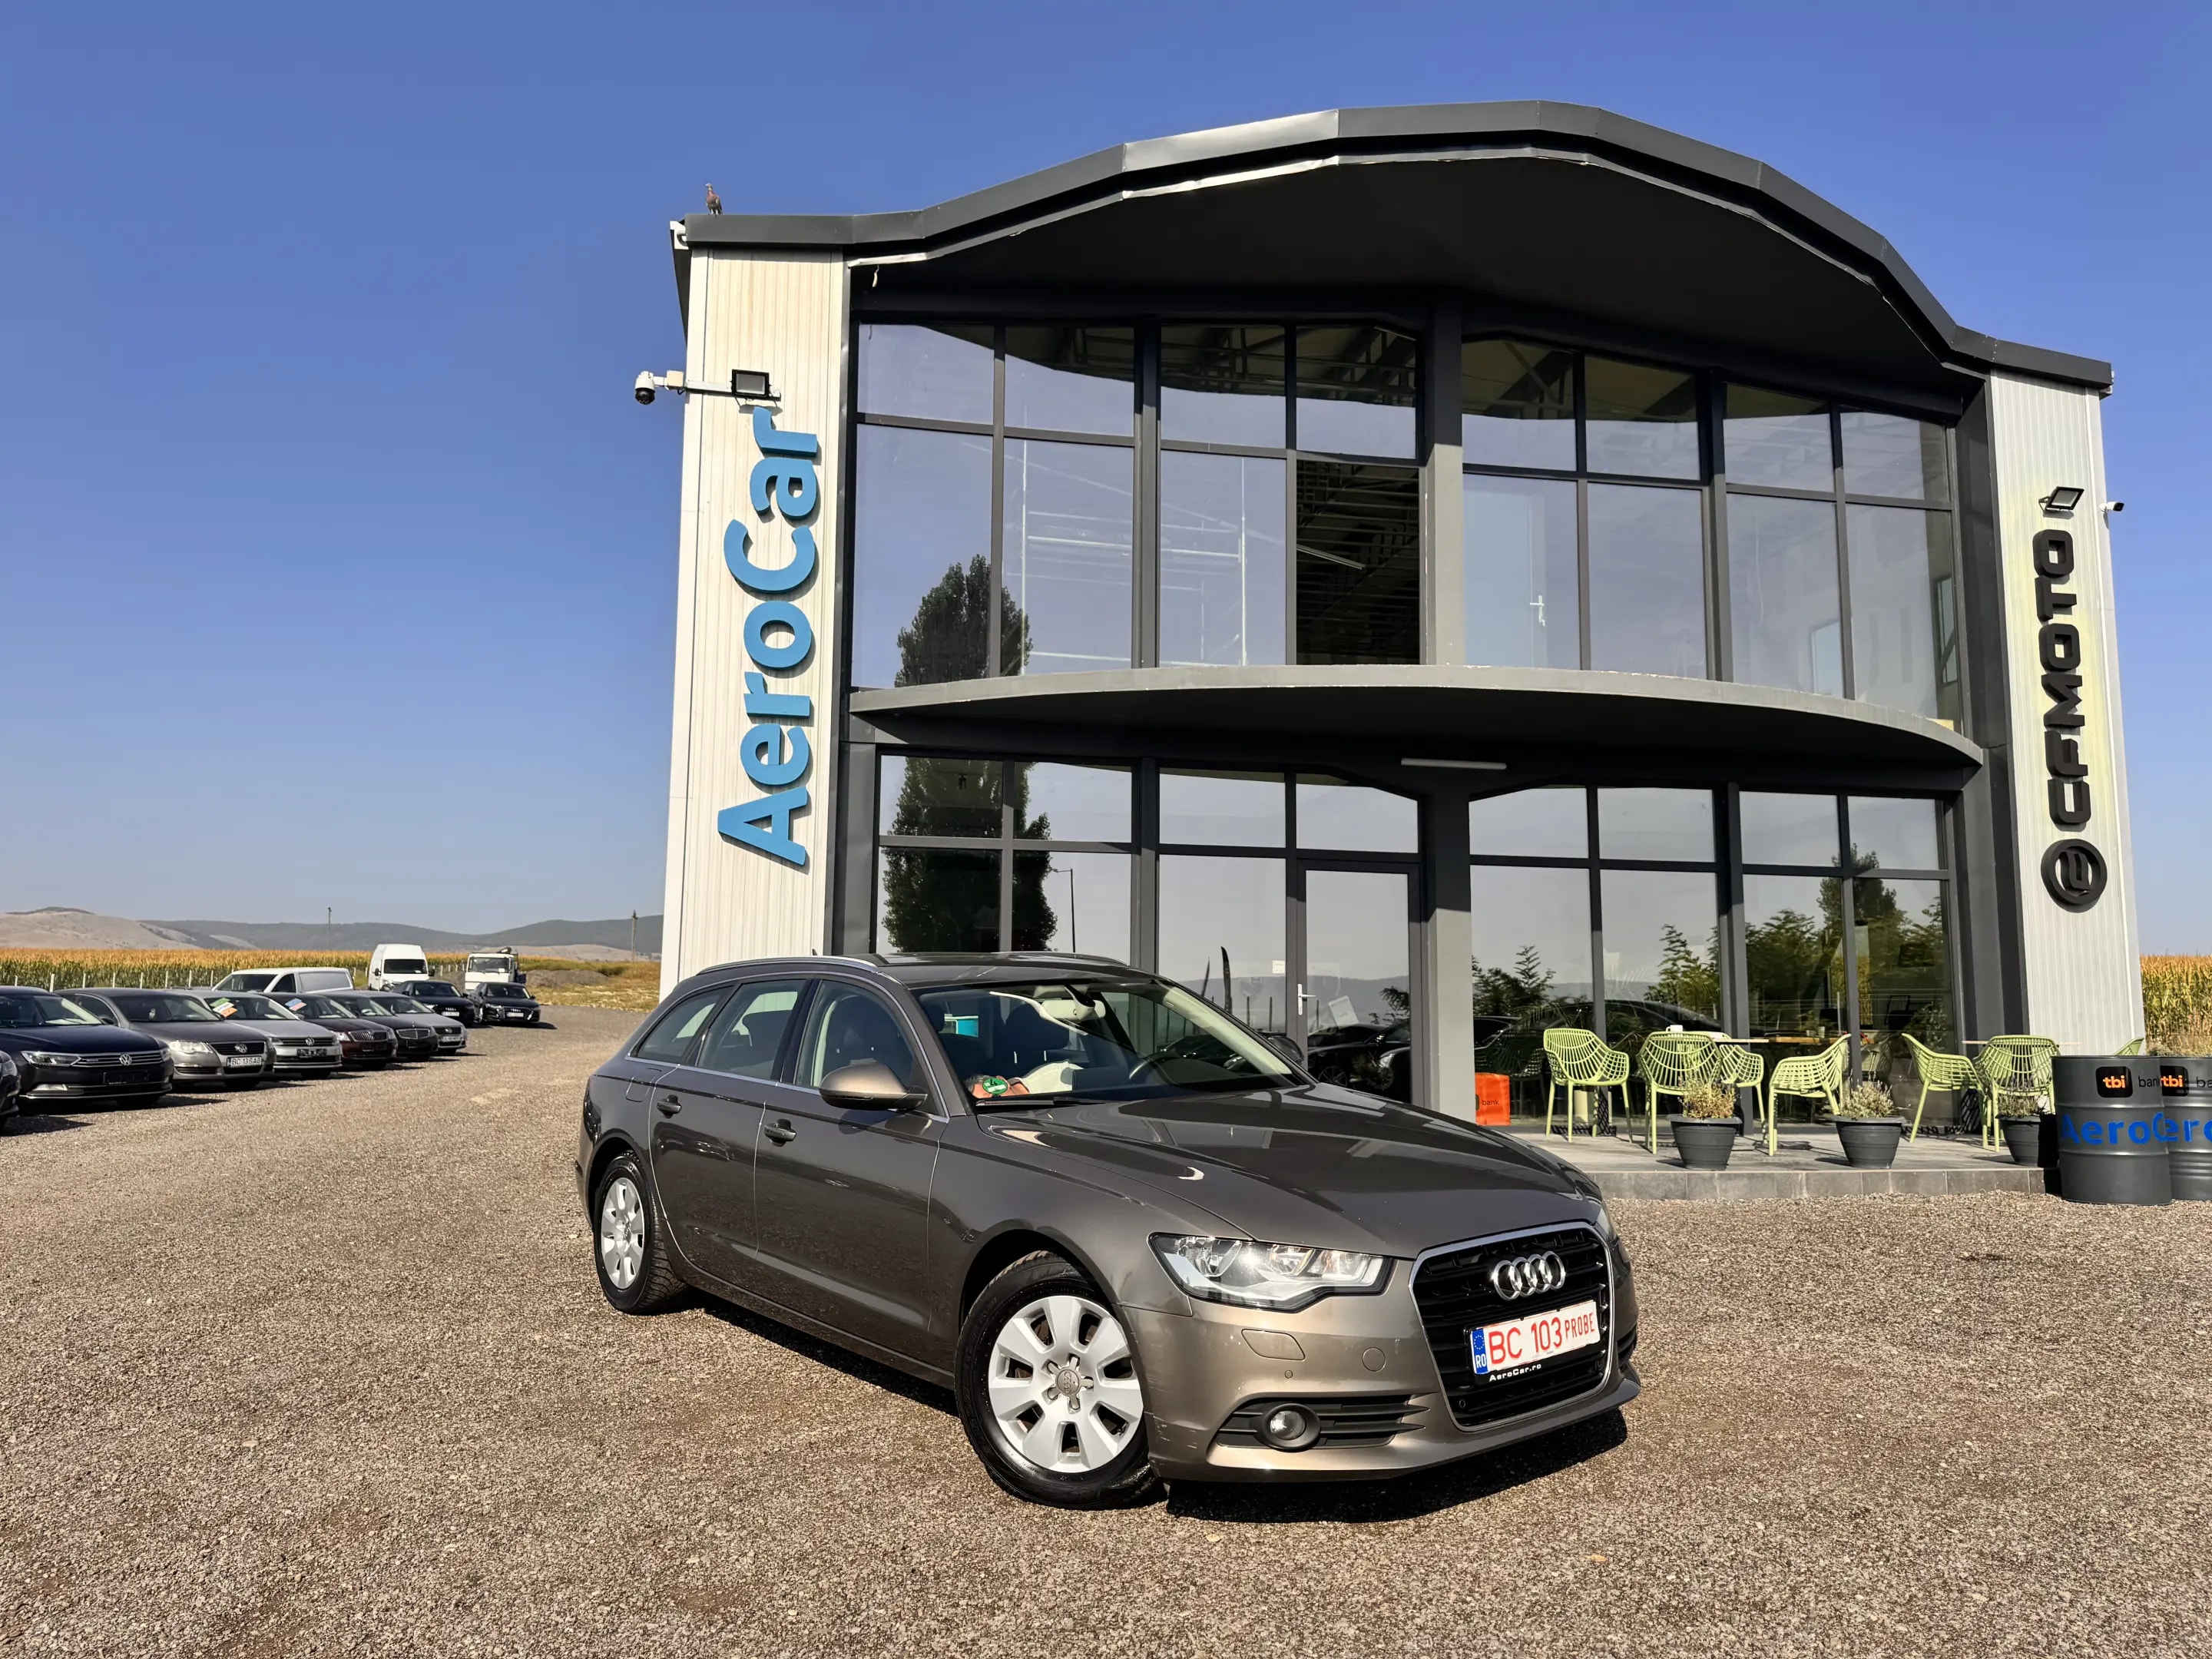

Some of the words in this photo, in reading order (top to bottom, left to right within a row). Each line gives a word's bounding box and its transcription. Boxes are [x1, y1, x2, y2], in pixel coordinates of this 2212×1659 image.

[718, 406, 818, 866] AeroCar
[2032, 528, 2091, 826] CFMOTO
[2103, 1075, 2125, 1088] tbi
[2137, 1076, 2160, 1088] ban
[2161, 1075, 2183, 1088] tbi
[1488, 1327, 1522, 1364] BC
[1531, 1317, 1562, 1353] 103
[1565, 1312, 1594, 1340] PROBE
[1475, 1354, 1486, 1369] RO
[1488, 1363, 1541, 1382] AeroCar.ro
